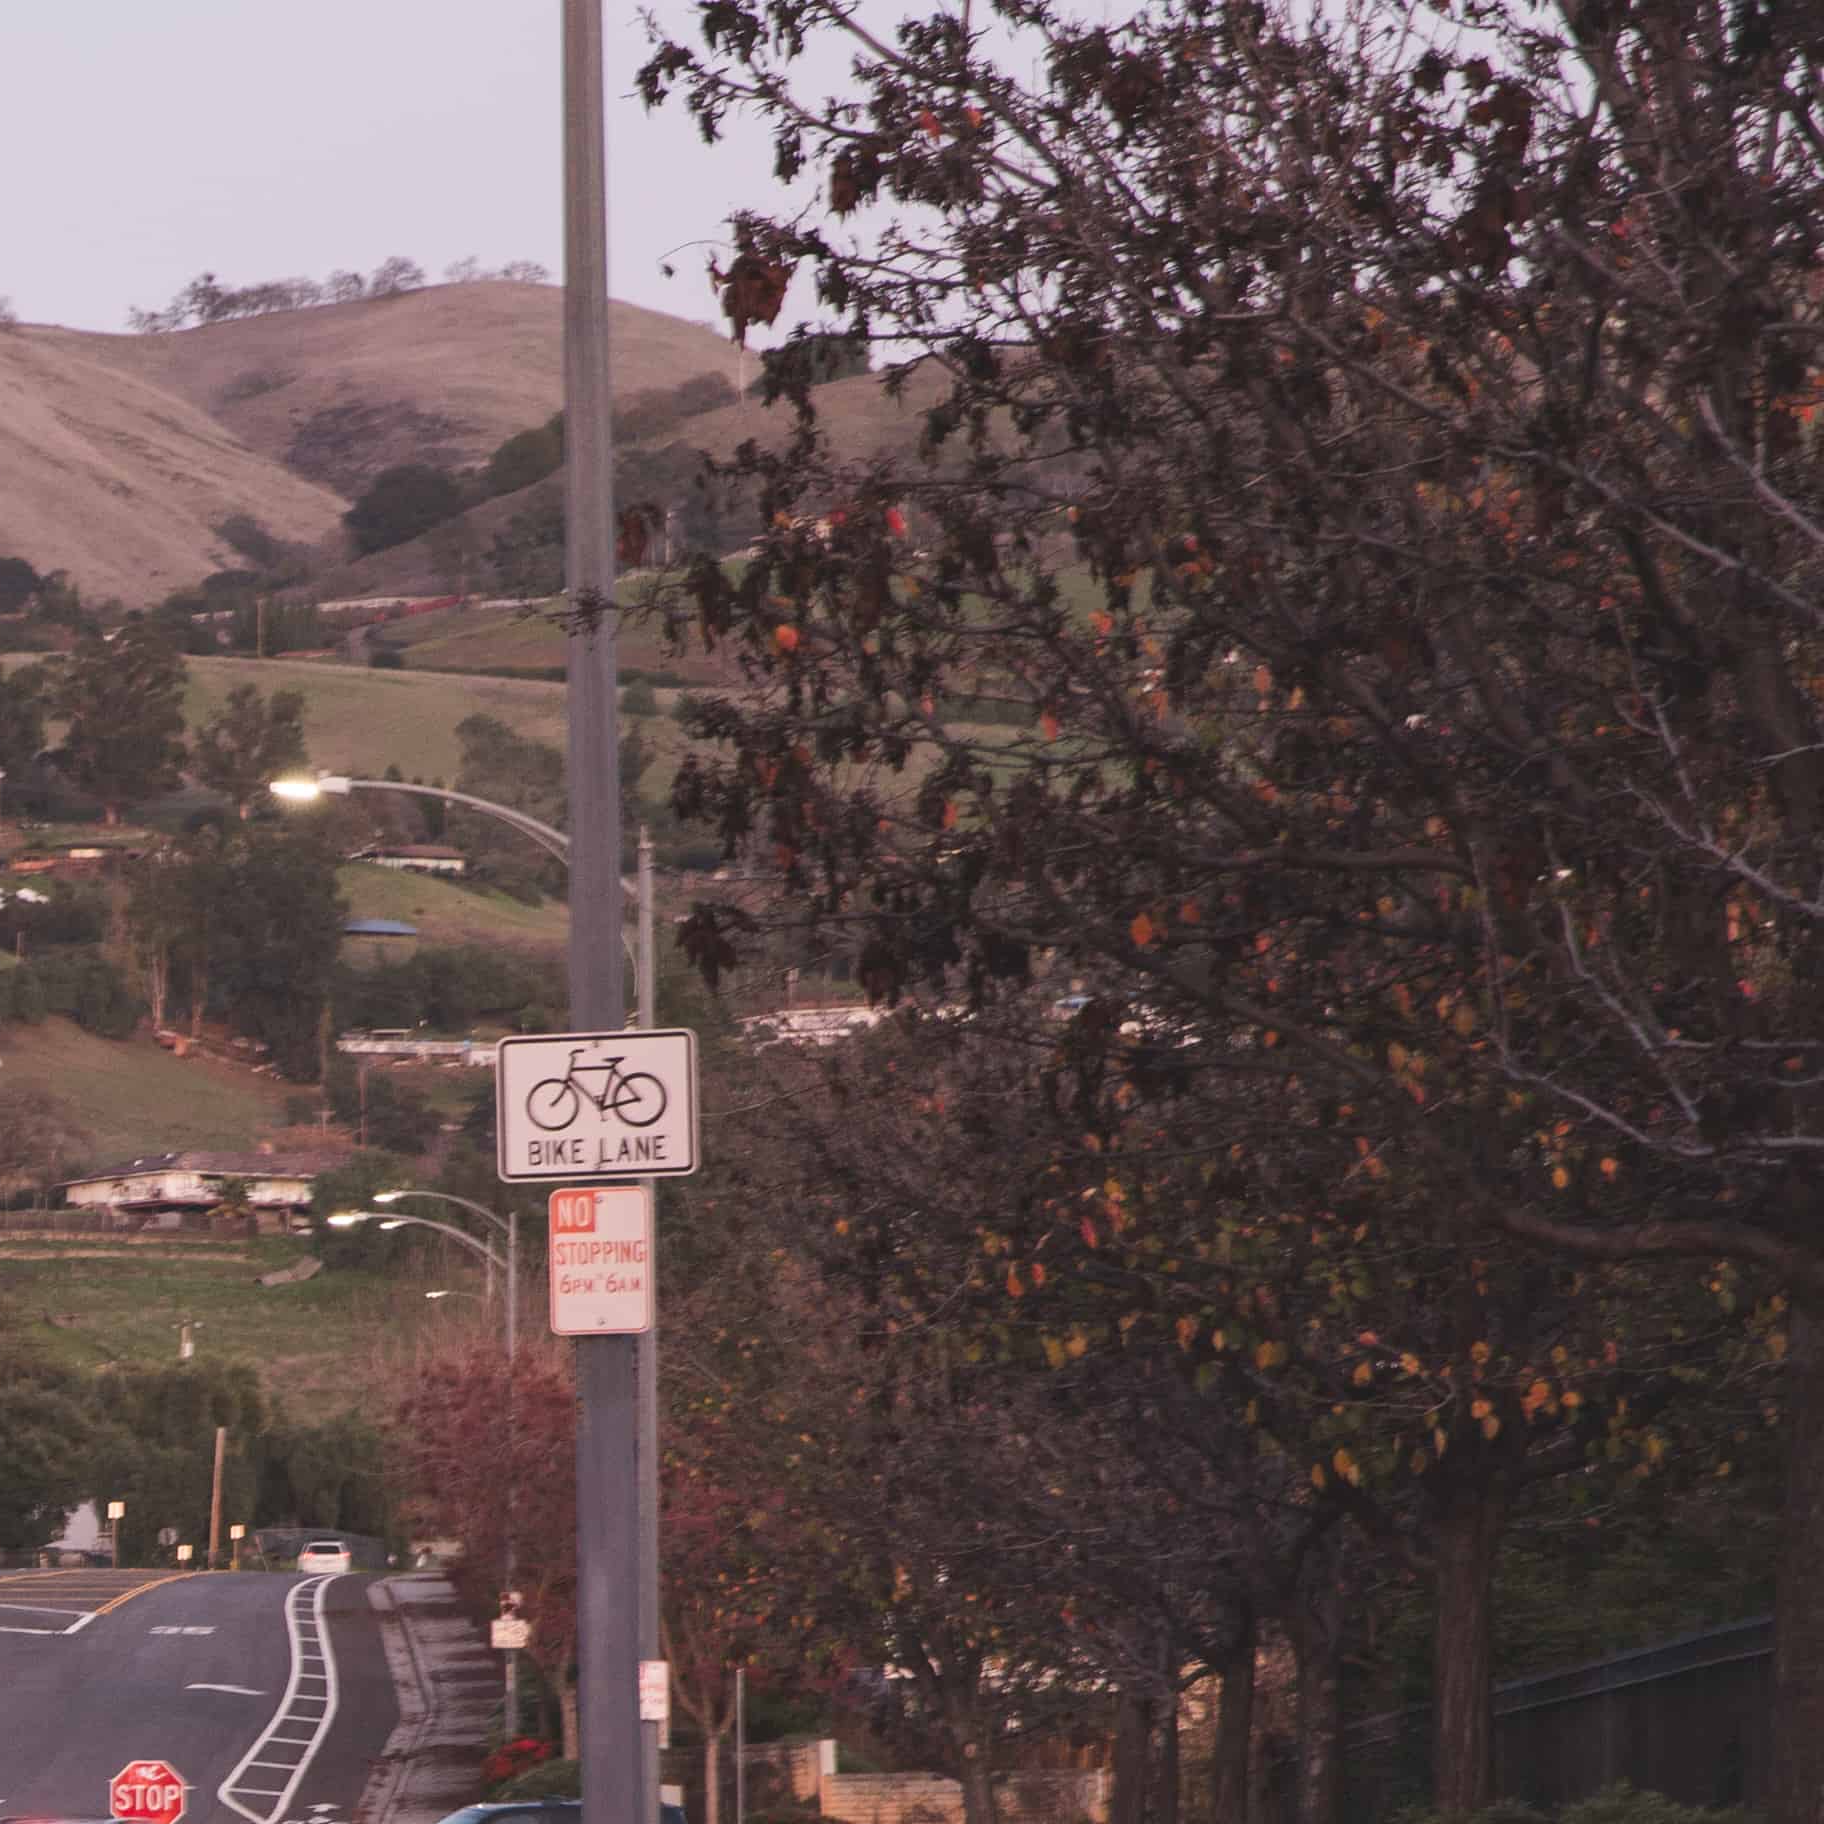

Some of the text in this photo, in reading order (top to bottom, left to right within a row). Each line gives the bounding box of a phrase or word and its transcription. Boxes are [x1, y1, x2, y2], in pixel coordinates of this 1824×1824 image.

[528, 1135, 668, 1166] BIKE LANE
[558, 1195, 592, 1227] NO
[553, 1240, 646, 1265] STOPPING
[115, 1784, 180, 1811] STOP
